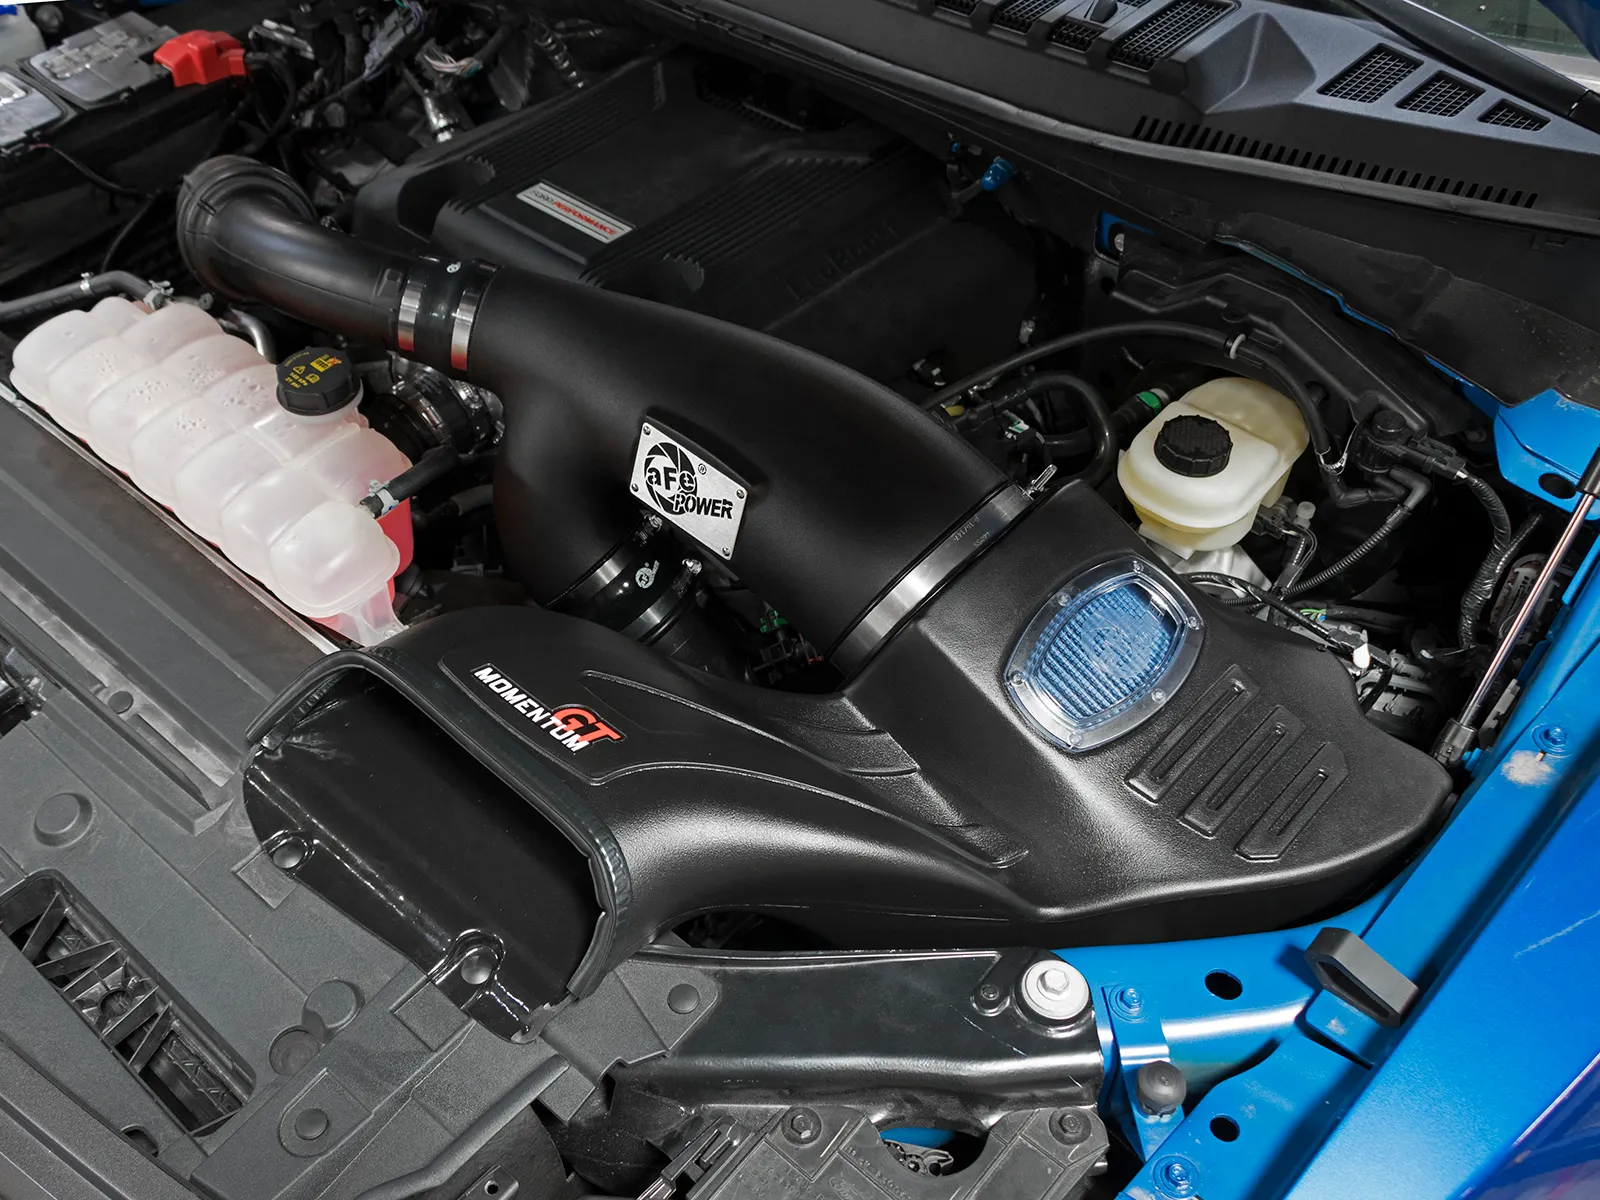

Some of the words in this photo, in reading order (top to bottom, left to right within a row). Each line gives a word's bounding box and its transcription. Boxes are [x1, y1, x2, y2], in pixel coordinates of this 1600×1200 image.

[646, 466, 696, 492] aFe
[673, 493, 734, 520] POWER
[473, 666, 590, 752] MOMENTUM
[552, 707, 622, 742] GT
